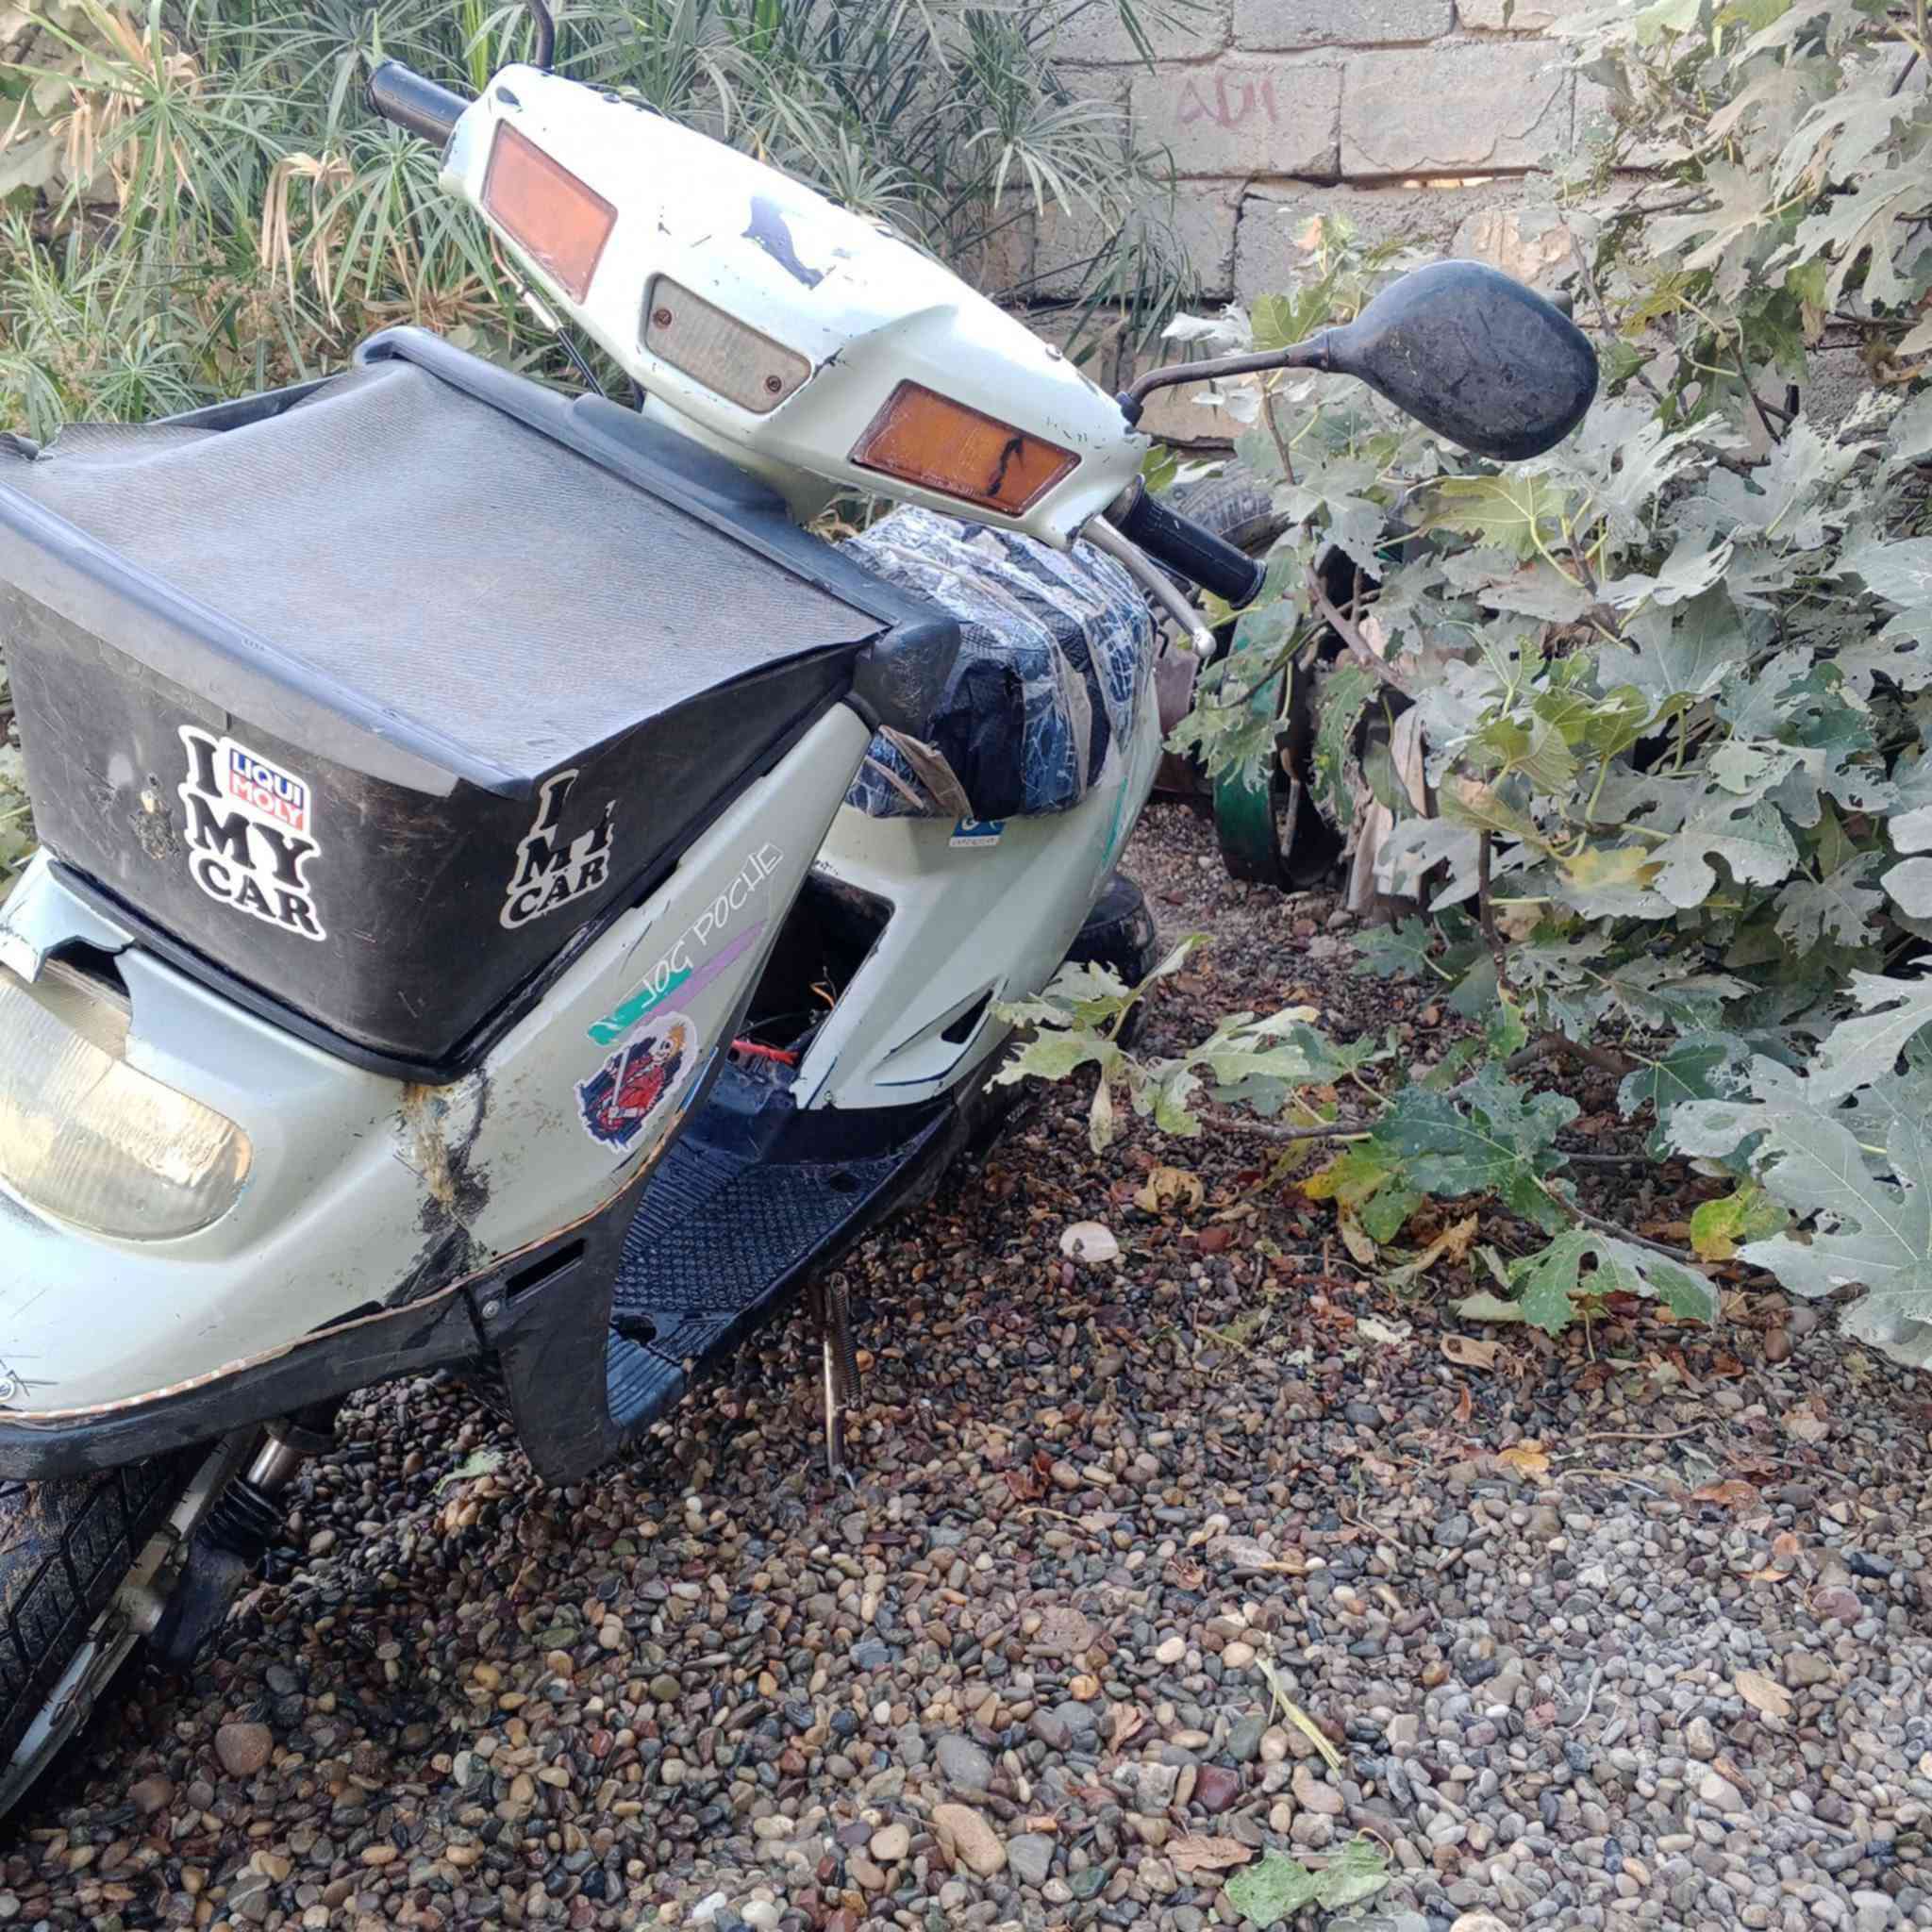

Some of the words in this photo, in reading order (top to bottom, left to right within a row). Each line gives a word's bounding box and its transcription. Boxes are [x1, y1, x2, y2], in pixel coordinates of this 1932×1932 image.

[187, 735, 225, 799] I
[231, 750, 303, 810] LIQUI
[231, 771, 303, 830] MOLY
[187, 792, 317, 889] MY
[197, 858, 322, 936] CAR
[508, 855, 607, 923] CAR
[641, 940, 694, 1008] JOG
[692, 842, 784, 946] POCHE
